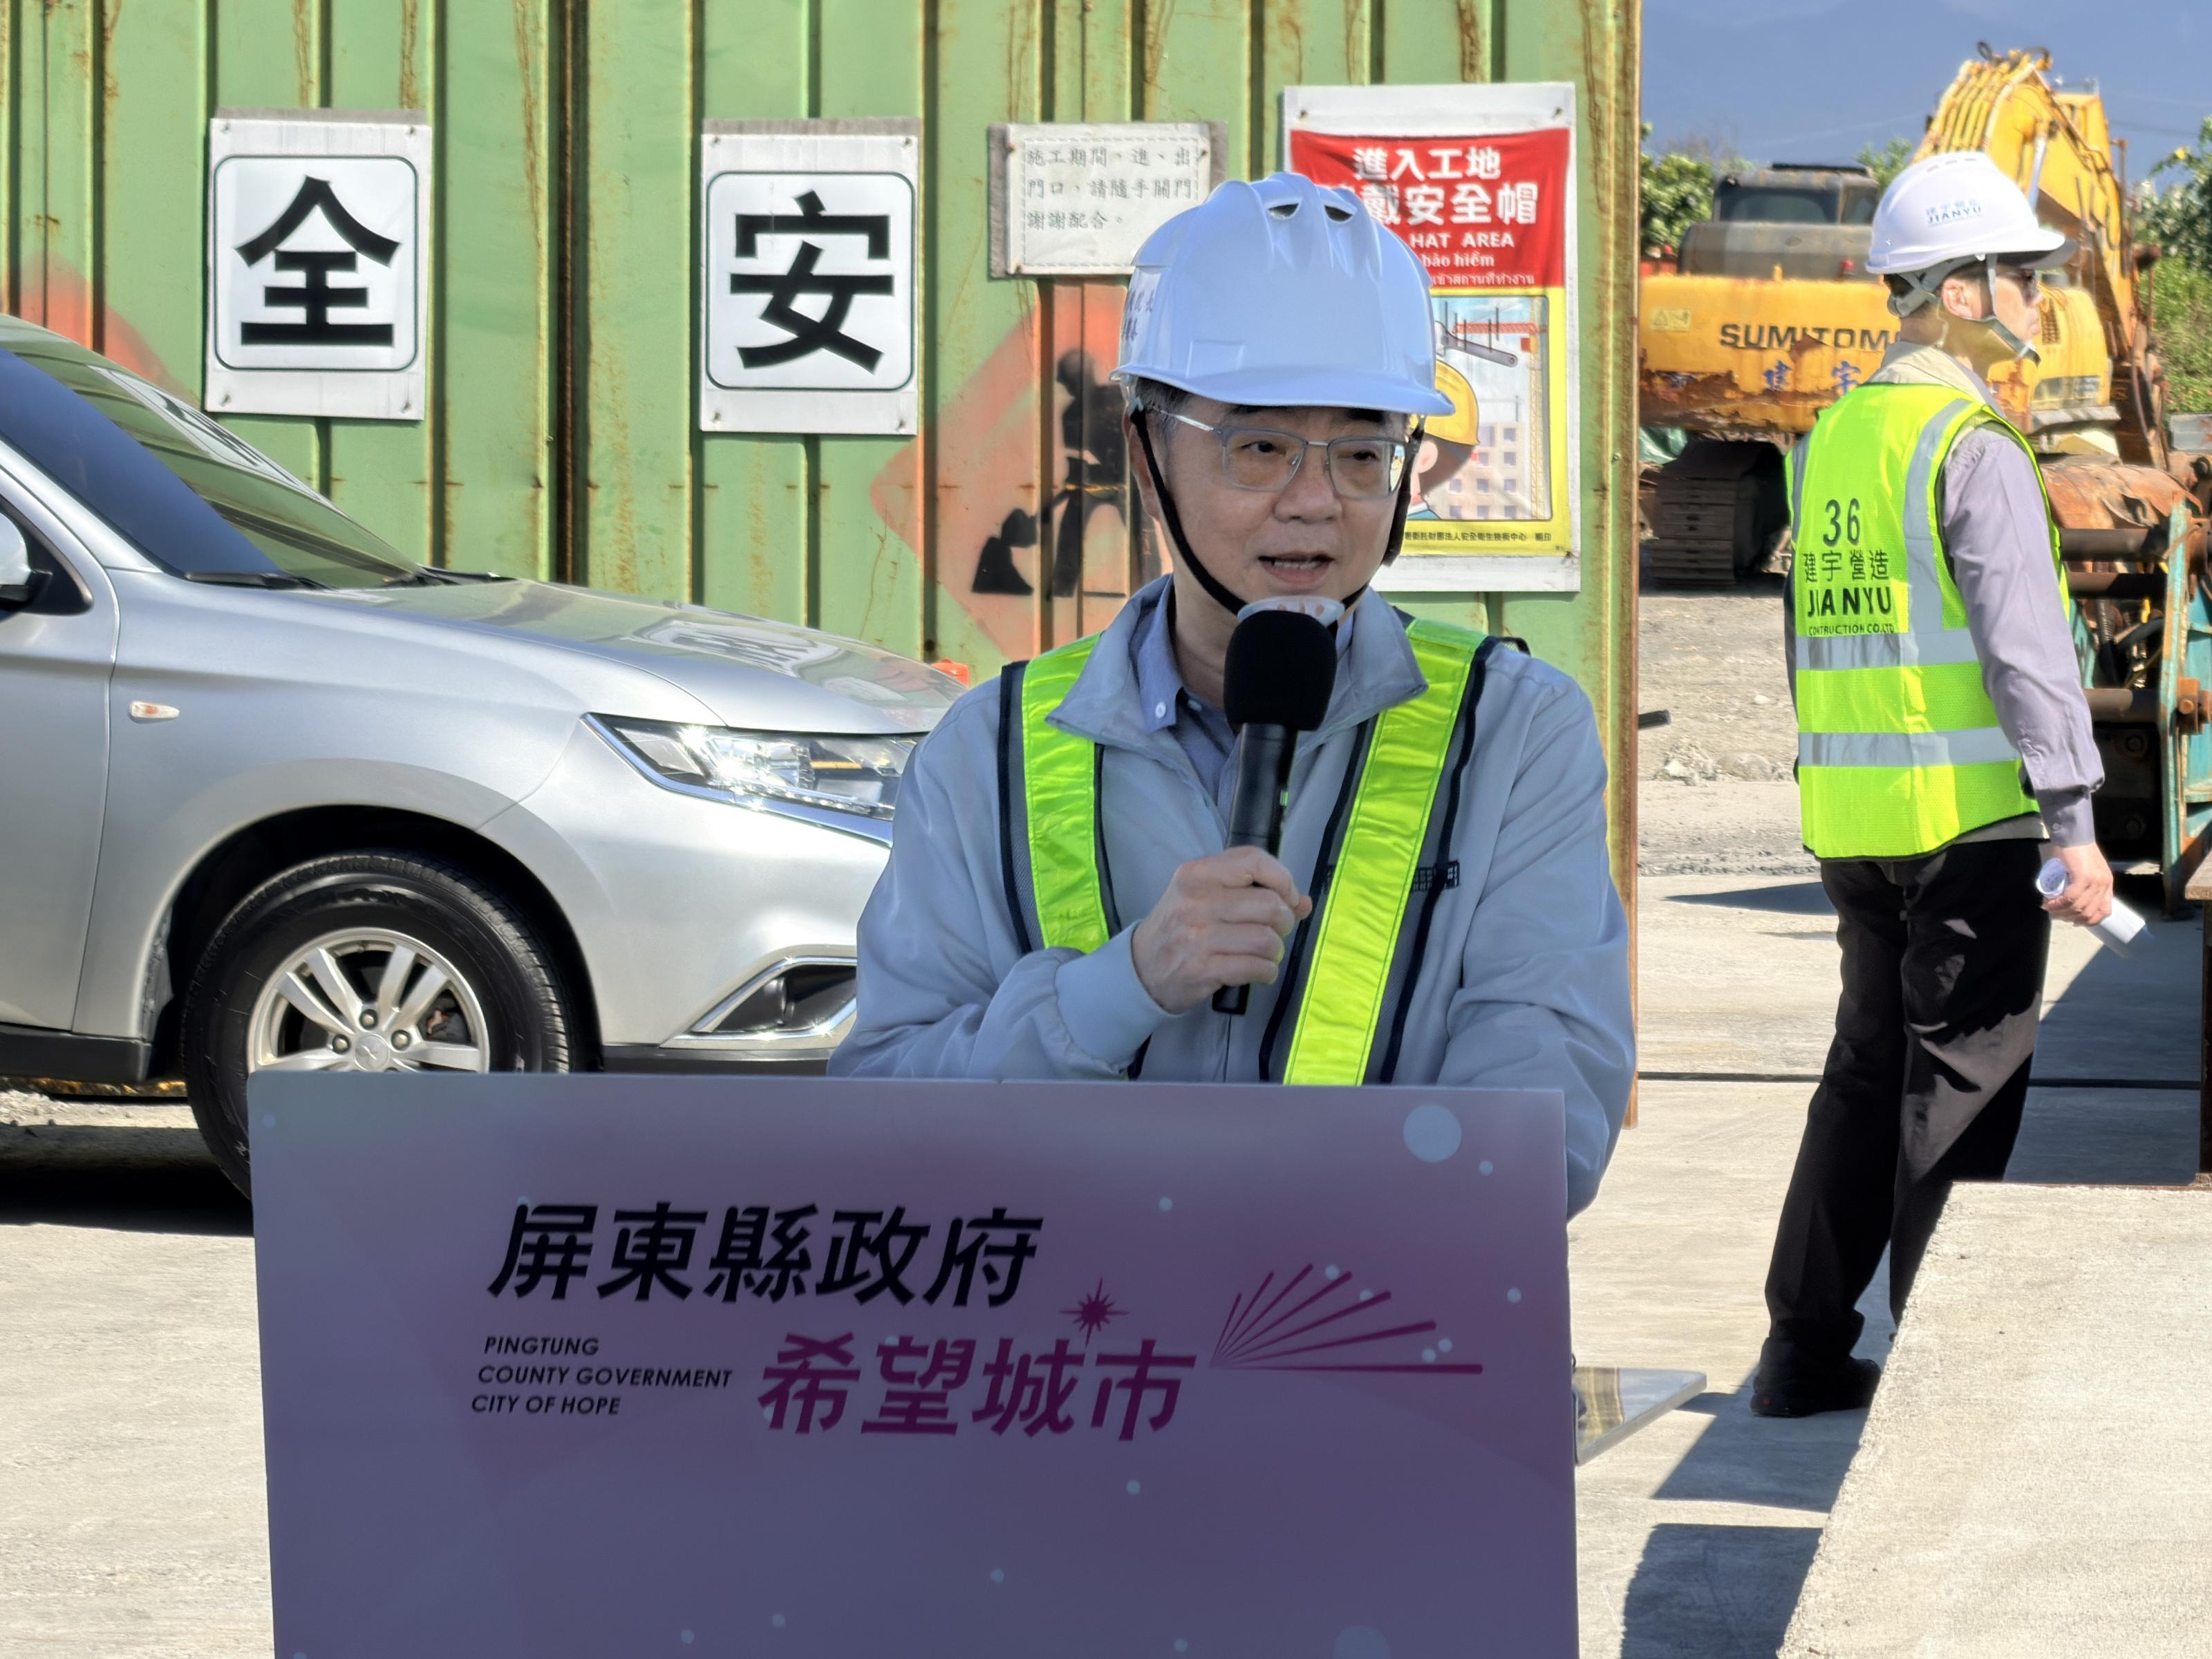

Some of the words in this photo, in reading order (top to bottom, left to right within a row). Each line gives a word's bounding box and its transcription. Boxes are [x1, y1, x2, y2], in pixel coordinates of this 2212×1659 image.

[1353, 146, 1501, 181] 進入工地
[1317, 182, 1539, 225] 戴安全帽
[1409, 232, 1451, 248] HAT
[1462, 231, 1515, 248] AREA
[236, 176, 400, 347] 全
[729, 190, 894, 374] 安
[1822, 498, 1861, 547] 36
[1802, 549, 1889, 583] 建宇營造
[1808, 586, 1892, 618] JIANYU
[487, 1201, 1044, 1308] 屏東縣政府
[484, 1335, 599, 1356] PINGTUNG
[478, 1365, 570, 1385] COUNTY
[576, 1366, 733, 1389] GOVERNMENT
[757, 1331, 1197, 1441] 希望城市
[471, 1394, 520, 1414] CITY
[525, 1395, 556, 1414] OF
[561, 1396, 621, 1416] HOPE
